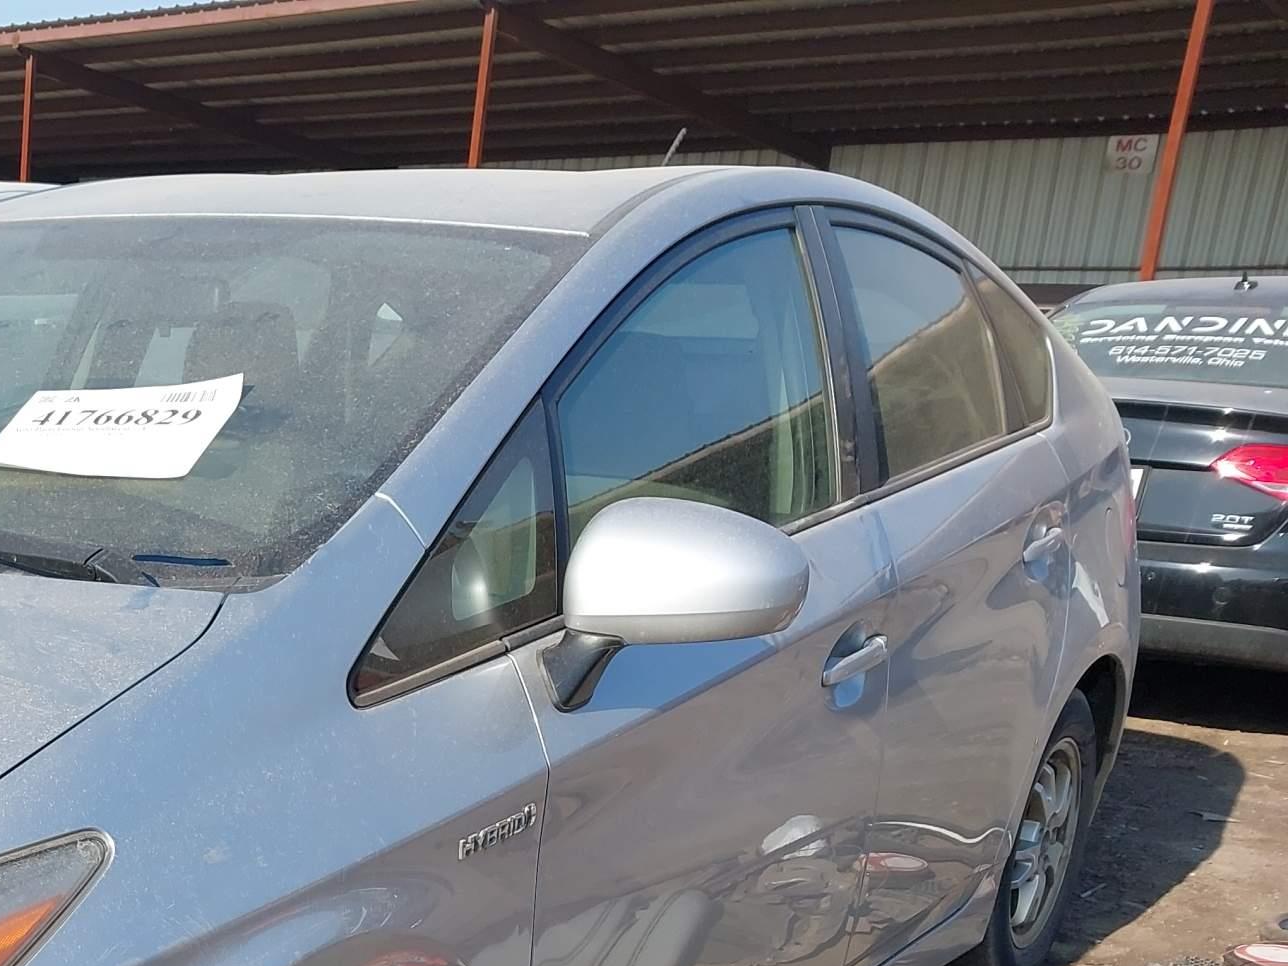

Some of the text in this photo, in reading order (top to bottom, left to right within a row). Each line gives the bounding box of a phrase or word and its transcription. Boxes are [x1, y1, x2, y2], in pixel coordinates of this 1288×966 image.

[1115, 138, 1148, 152] MC
[1115, 156, 1142, 170] 30
[1207, 357, 1246, 368] Ohio
[31, 408, 203, 426] 41766829
[458, 811, 527, 861] HYBRID
